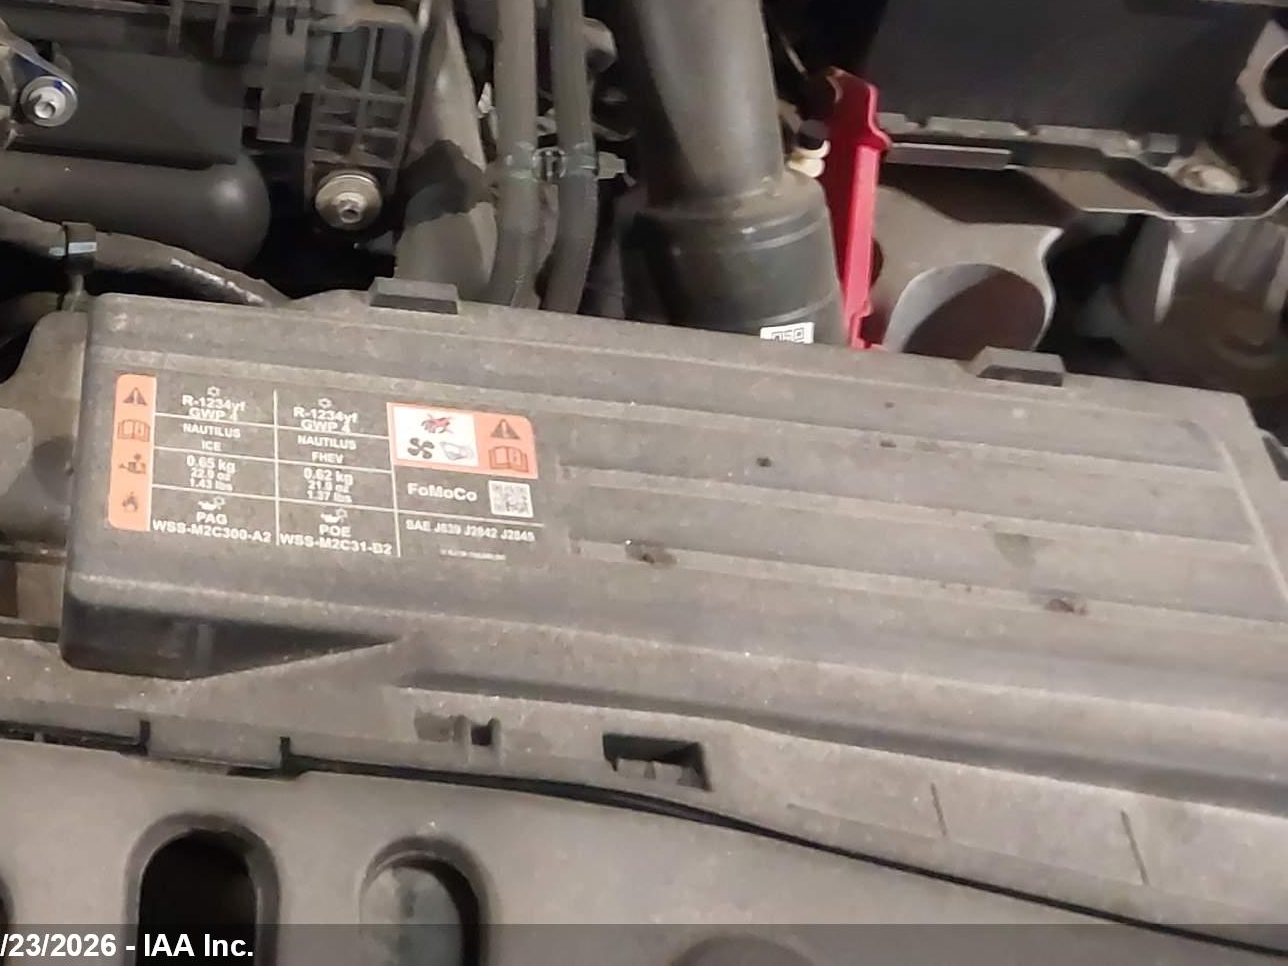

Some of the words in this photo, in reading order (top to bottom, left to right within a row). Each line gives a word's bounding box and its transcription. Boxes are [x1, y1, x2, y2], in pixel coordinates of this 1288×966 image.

[182, 394, 246, 412] R-1234yf
[188, 407, 226, 422] GWP
[293, 406, 358, 423] R-1234yf
[182, 423, 241, 438] NAUTILUS
[300, 419, 338, 433] GWP
[201, 440, 222, 451] ICE
[297, 435, 357, 451] NAUTILUS
[311, 452, 345, 464] FHEV
[218, 459, 236, 474] kg
[303, 467, 333, 481] 0.62
[335, 470, 354, 486] kg
[407, 482, 478, 502] FoMoCo
[196, 512, 228, 525] PAG
[405, 519, 431, 532] SAE
[319, 524, 352, 538] POE
